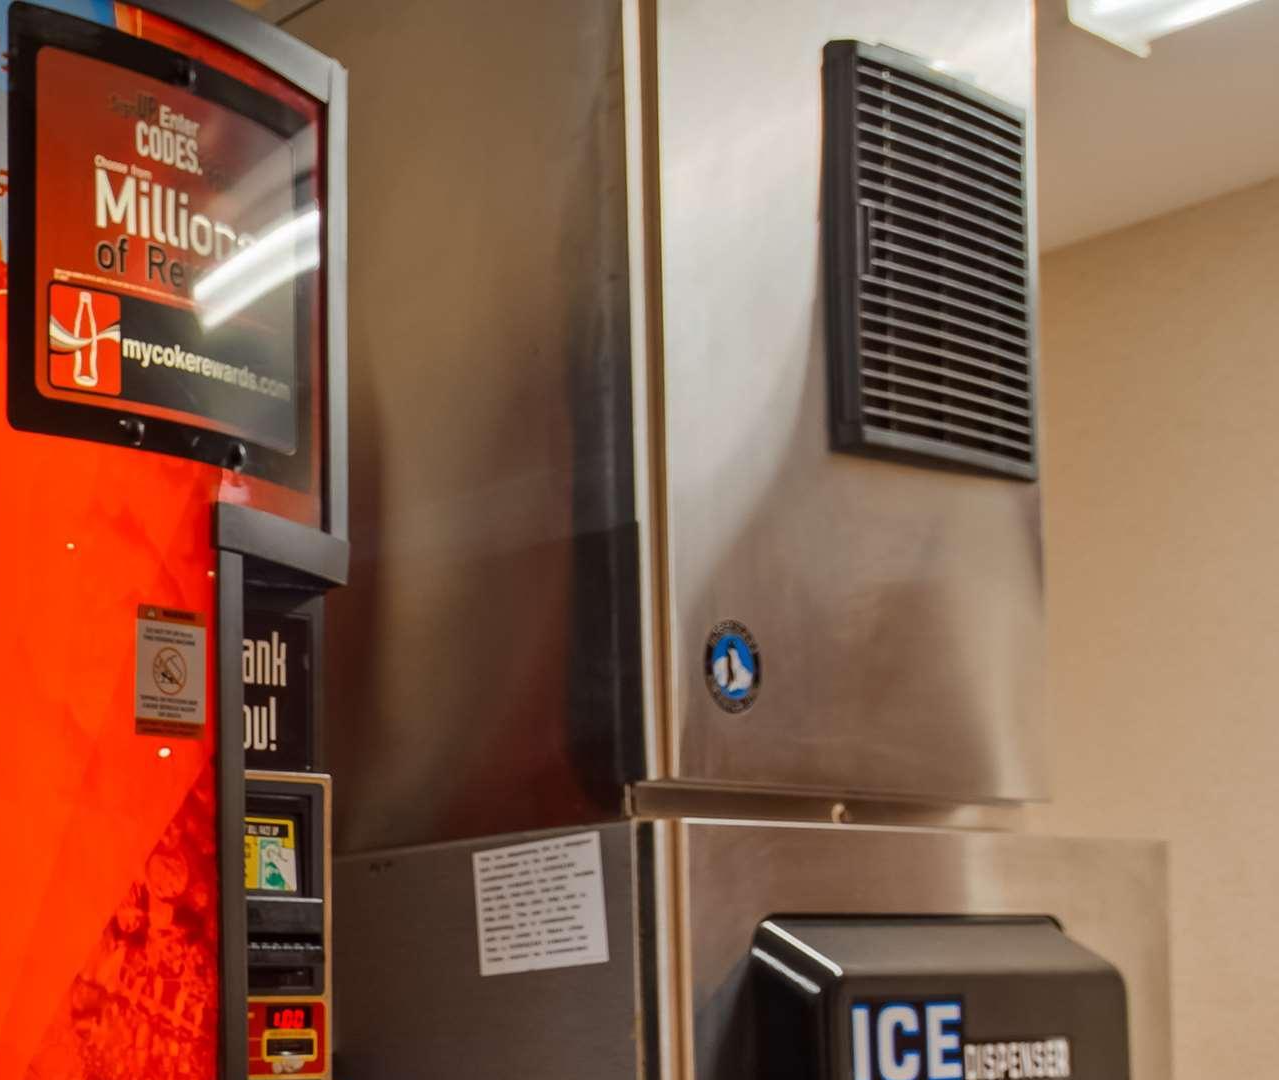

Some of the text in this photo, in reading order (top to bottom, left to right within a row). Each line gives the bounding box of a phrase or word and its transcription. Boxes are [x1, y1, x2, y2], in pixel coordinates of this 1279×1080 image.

[135, 120, 203, 176] CODES.
[159, 104, 200, 136] Enter
[96, 237, 129, 274] of
[122, 335, 291, 398] mycokerewards.com
[242, 631, 288, 687] ank
